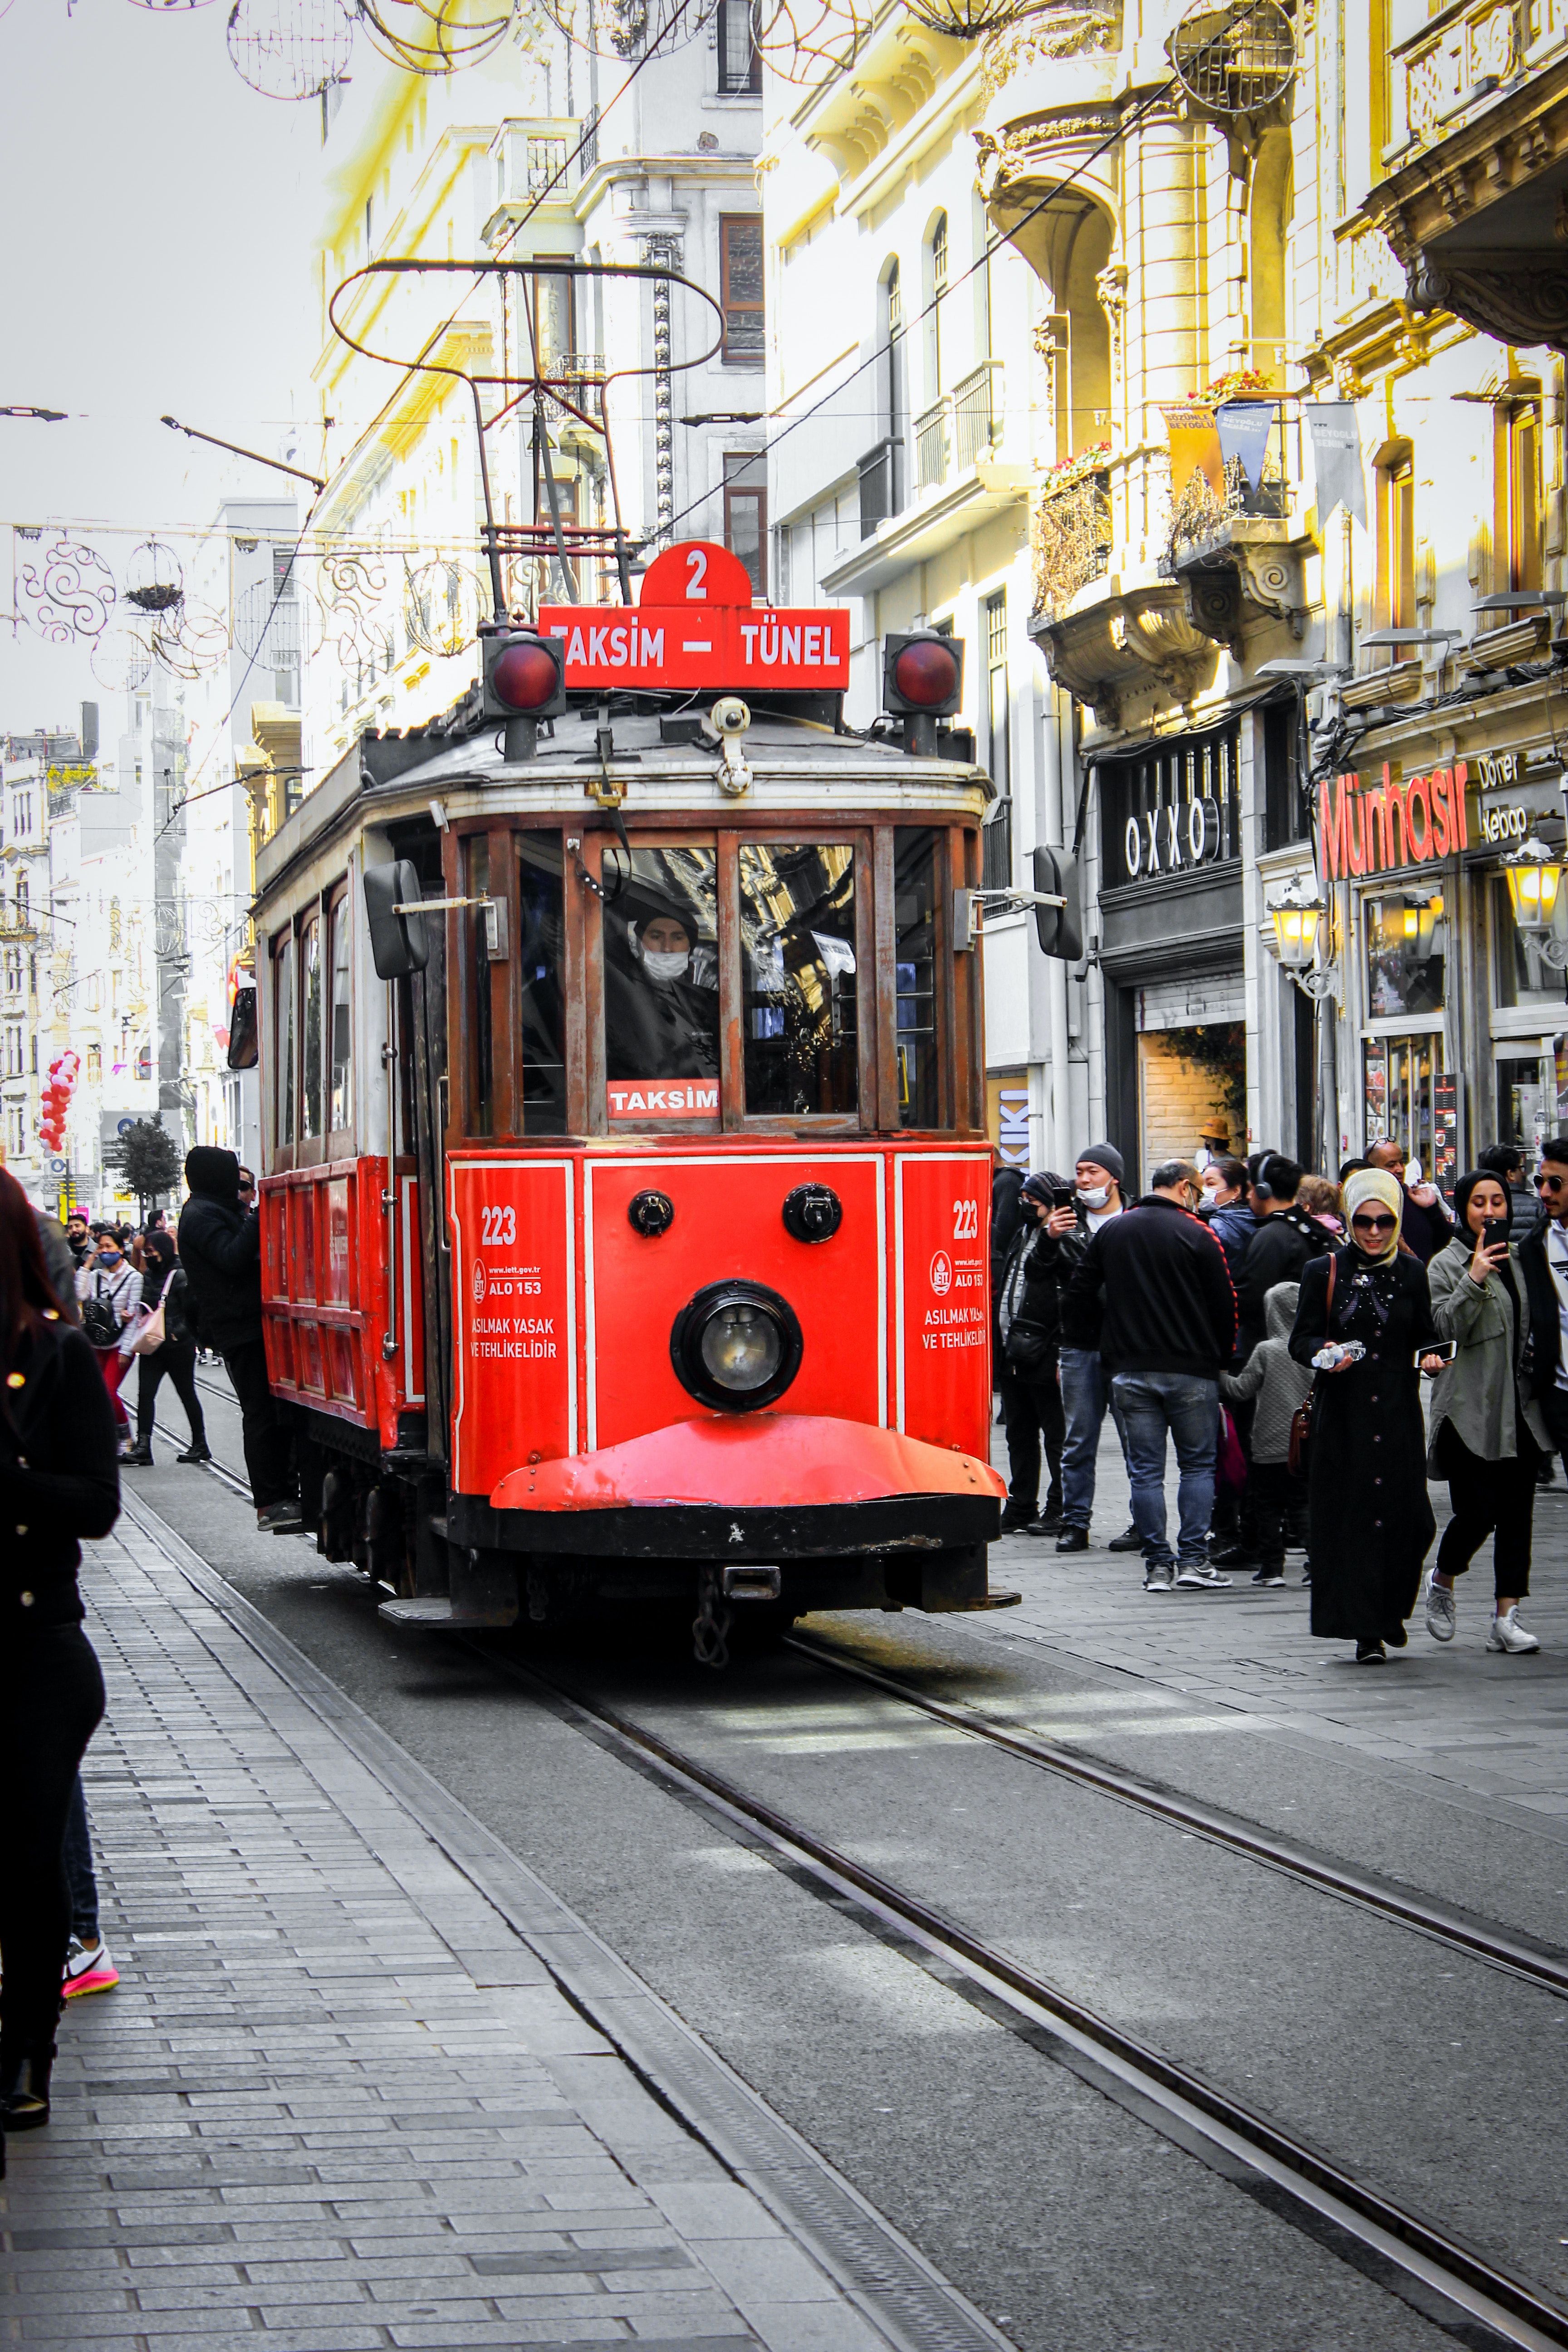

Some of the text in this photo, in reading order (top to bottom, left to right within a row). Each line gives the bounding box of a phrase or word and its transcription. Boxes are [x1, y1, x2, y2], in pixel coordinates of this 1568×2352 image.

[686, 549, 707, 599] 2
[550, 616, 665, 667] TAKSİM
[740, 614, 841, 666] TÜNEL
[1125, 797, 1205, 876] OXXO
[610, 1086, 719, 1111] TAKSİM
[481, 1205, 517, 1246] 223
[953, 1199, 978, 1240] 223
[489, 1266, 541, 1275] www.iett.gov.tr
[489, 1282, 542, 1295] ALO 153
[955, 1274, 983, 1287] ALO 153
[472, 1318, 554, 1334] ASILMAK YASAK
[925, 1308, 969, 1325] ASILMAK
[470, 1339, 557, 1358] VE TEHLİKELİDİR
[922, 1333, 937, 1349] VE
